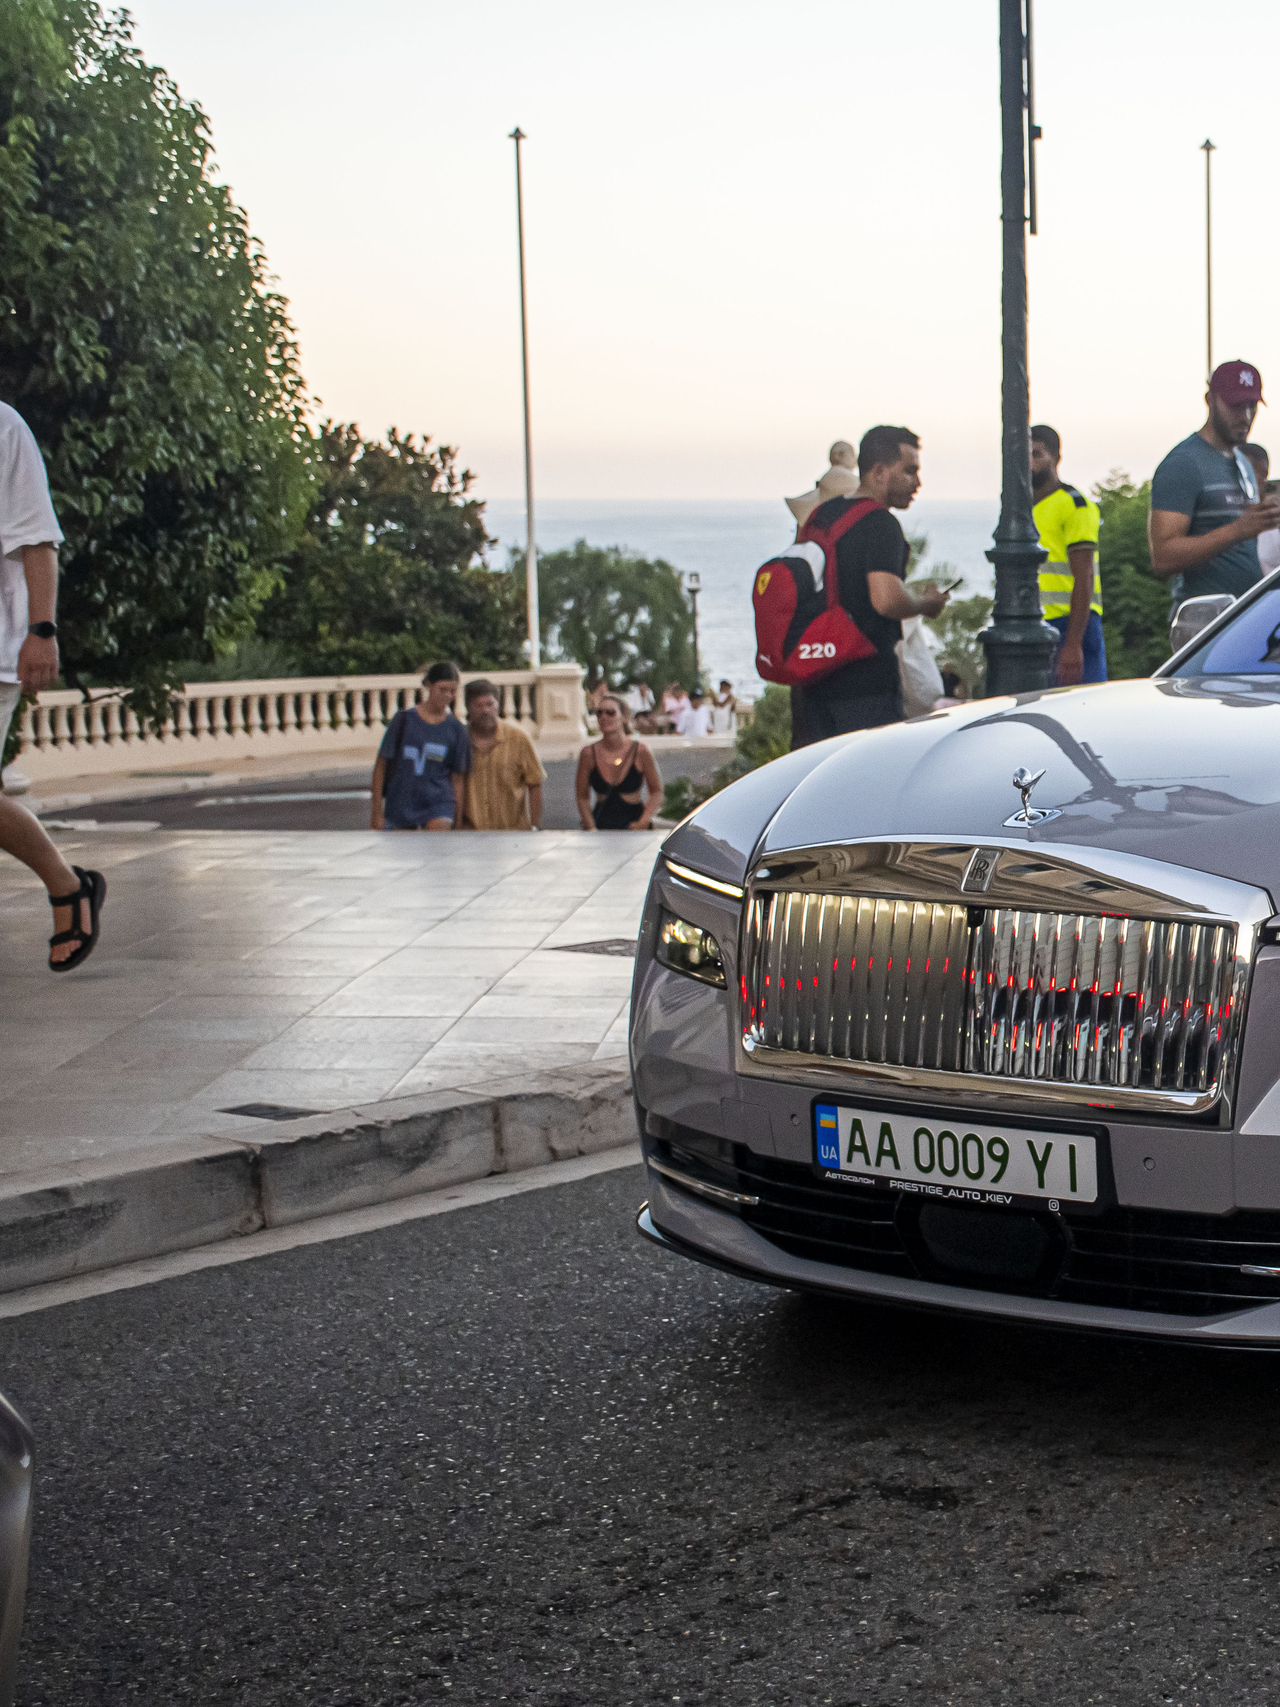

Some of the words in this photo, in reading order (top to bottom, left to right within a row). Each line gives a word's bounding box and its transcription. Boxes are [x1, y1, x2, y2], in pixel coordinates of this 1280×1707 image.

[799, 642, 836, 659] 220
[820, 1144, 838, 1160] UA
[846, 1117, 901, 1171] AA
[913, 1126, 1010, 1184] 0009
[1026, 1139, 1078, 1193] YI
[889, 1180, 1013, 1205] PRESTIGE_AUTO_KIEV
